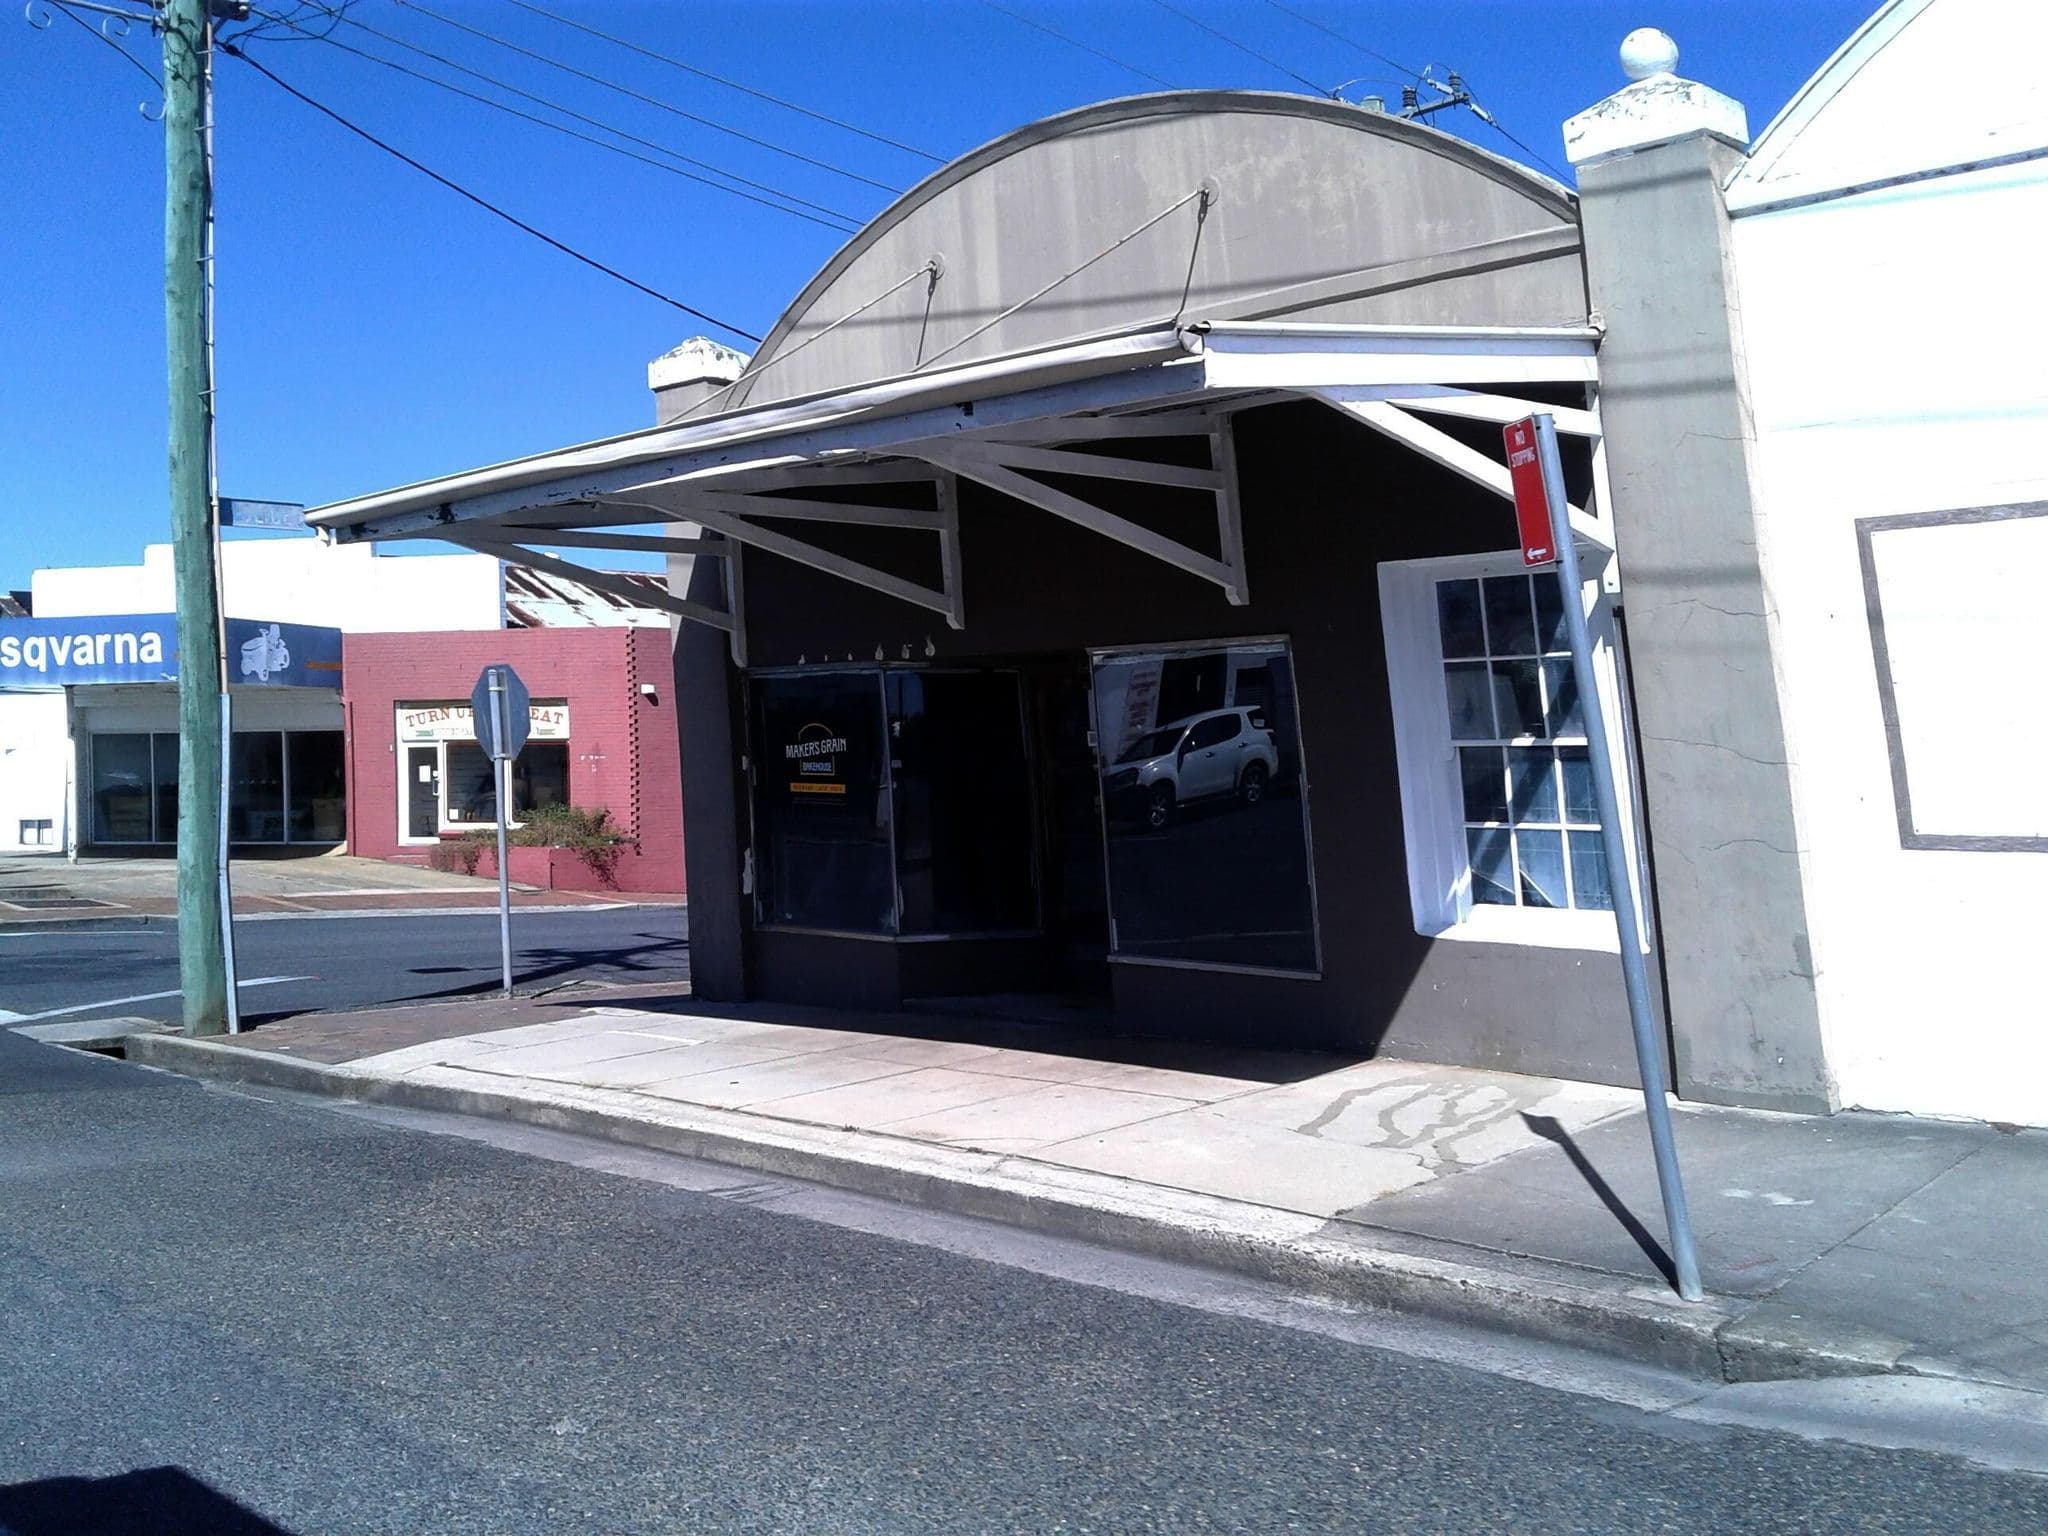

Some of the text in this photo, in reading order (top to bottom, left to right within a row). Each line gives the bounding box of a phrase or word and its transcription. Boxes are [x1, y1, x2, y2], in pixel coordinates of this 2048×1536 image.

[1514, 430, 1525, 446] NO
[1511, 446, 1535, 467] STOPPING
[0, 631, 163, 673] sqvarna
[405, 707, 450, 727] TURN
[530, 708, 563, 724] EAT
[820, 738, 846, 753] GRAIN
